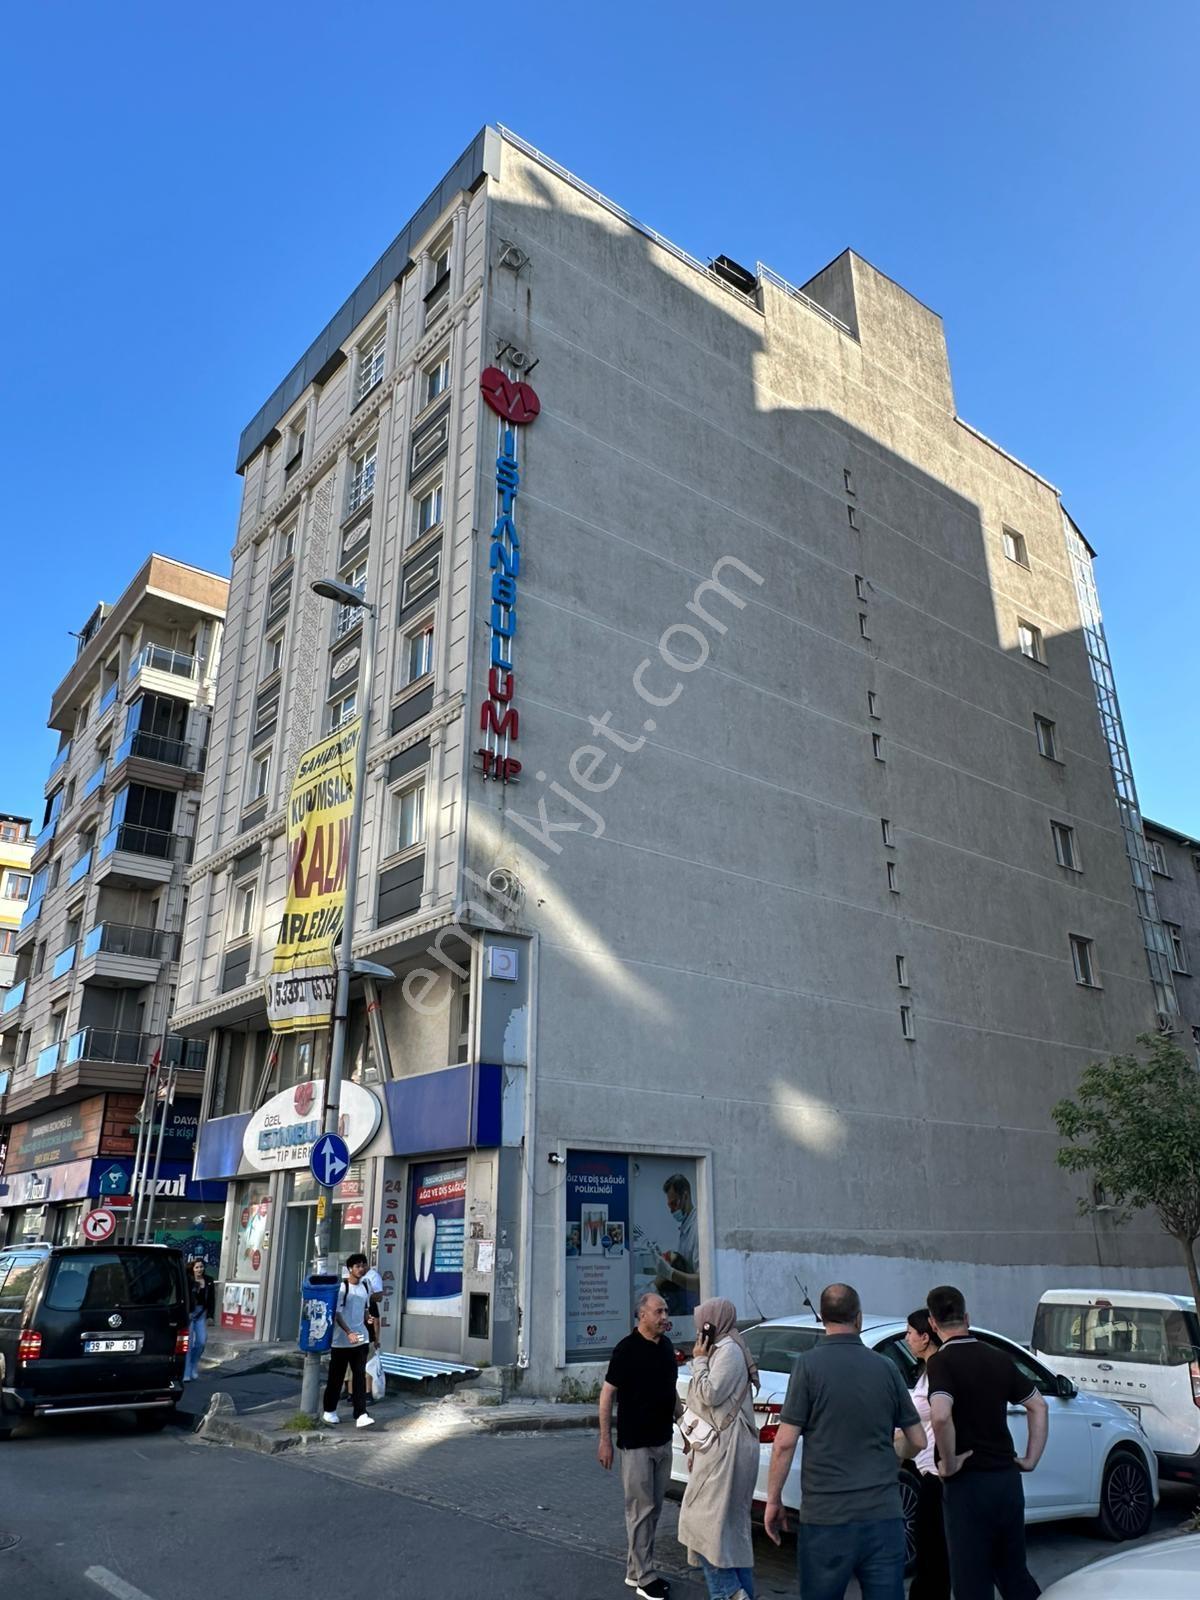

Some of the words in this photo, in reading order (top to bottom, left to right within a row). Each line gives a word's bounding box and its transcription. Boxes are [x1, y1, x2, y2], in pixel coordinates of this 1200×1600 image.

[478, 748, 521, 784] TIP
[264, 1114, 282, 1127] ÖZEL
[276, 1150, 289, 1163] TIP
[384, 1180, 402, 1193] 24
